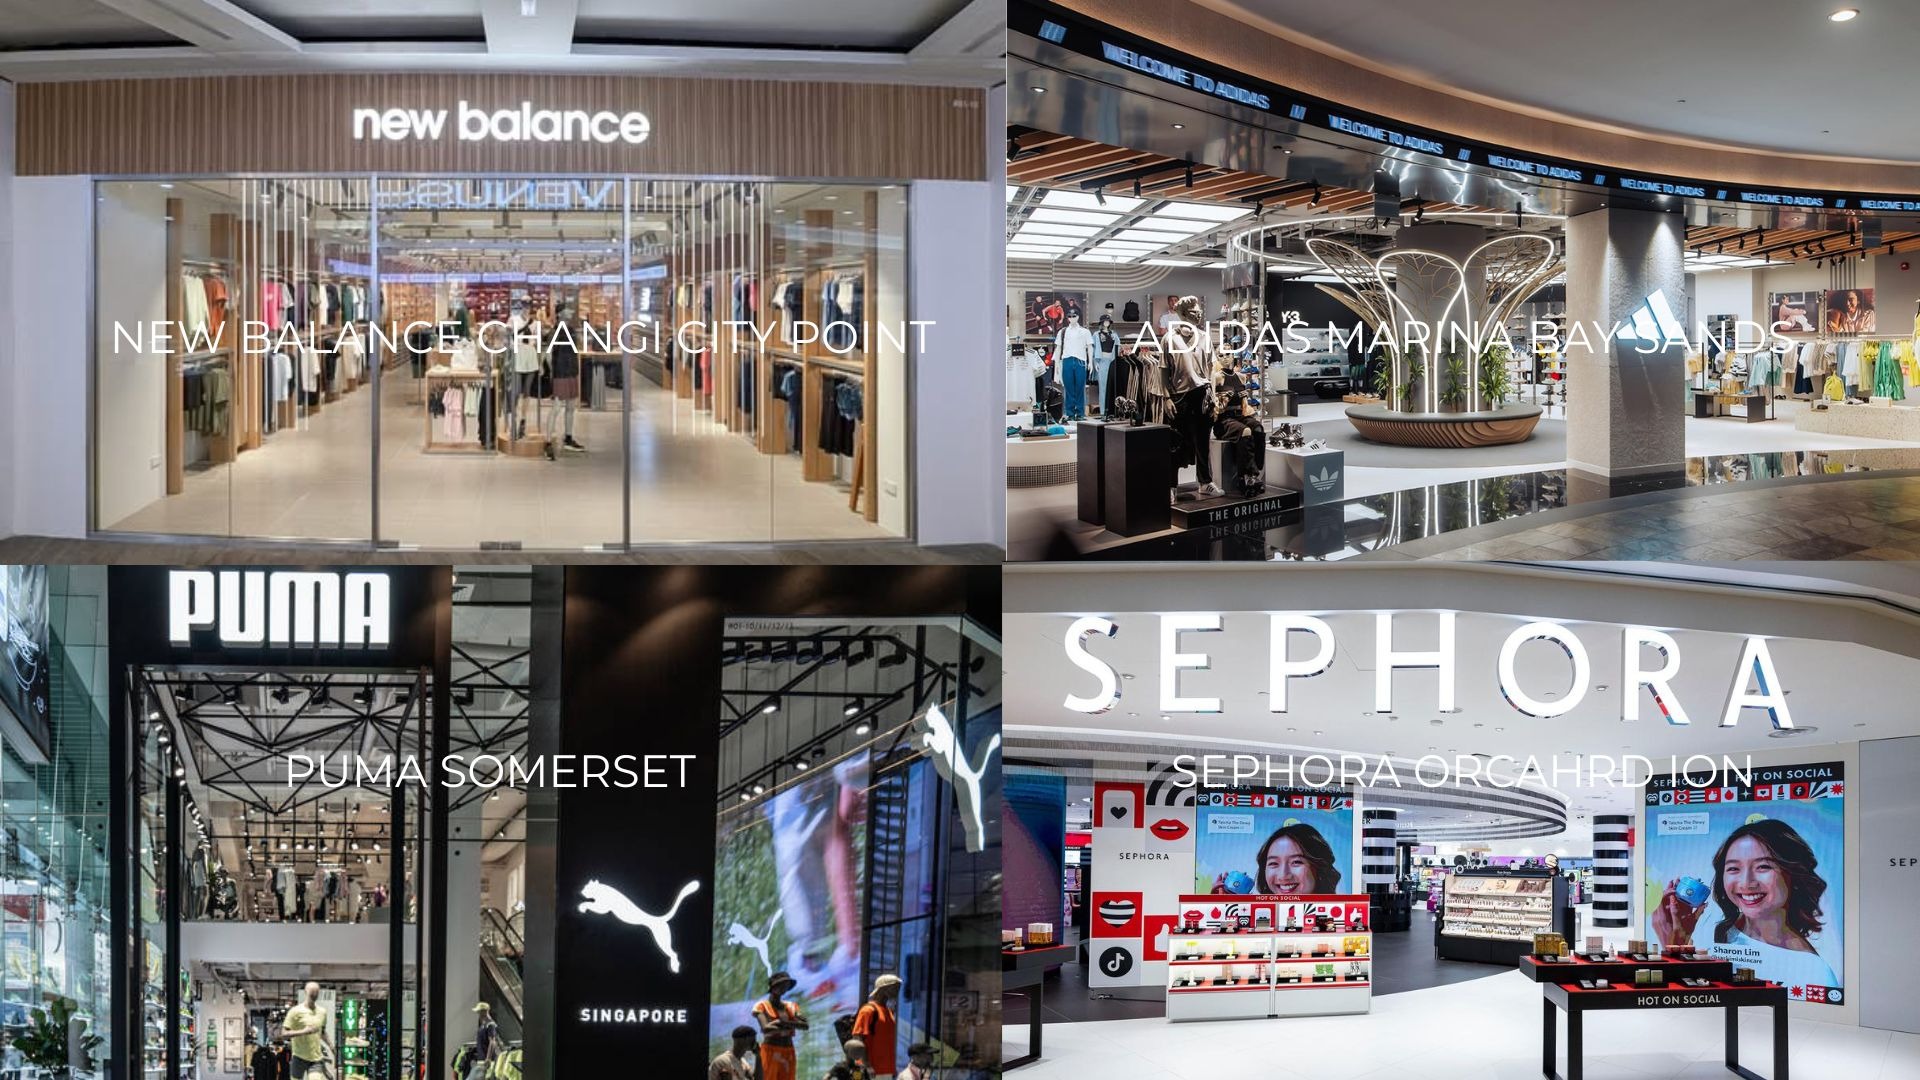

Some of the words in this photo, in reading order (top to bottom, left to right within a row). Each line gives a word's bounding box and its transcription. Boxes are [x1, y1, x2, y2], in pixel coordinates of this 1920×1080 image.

[1101, 40, 1192, 86] WELCOME
[1191, 72, 1215, 93] TO
[1214, 81, 1270, 109] ADIDAS
[354, 107, 448, 141] new
[458, 100, 651, 143] balance
[1328, 114, 1387, 142] WELCOME
[1387, 130, 1404, 145] TO
[1404, 135, 1444, 155] ADIDAS
[1487, 154, 1535, 173] WELCOME
[1533, 163, 1549, 176] TO
[1549, 167, 1582, 180] ADIDAS
[1620, 178, 1662, 192] WELCOME
[1661, 183, 1674, 194] TO
[1674, 185, 1705, 197] ADIDAS
[1740, 192, 1782, 204] WELCOME
[1781, 195, 1793, 204] TO
[1793, 196, 1824, 206] ADIDAS
[1208, 508, 1229, 522] THE
[1234, 499, 1282, 517] ORIGINAL
[169, 570, 391, 647] PUMA
[1063, 612, 1796, 730] SEPHORA
[1763, 771, 1782, 780] ON
[1787, 768, 1833, 779] SOCIAL
[1119, 852, 1170, 861] SEPHORA
[1889, 858, 1918, 867] SEP
[1713, 946, 1743, 955] Sharon
[1744, 948, 1760, 957] Lim
[1637, 996, 1660, 1005] HOT
[1662, 995, 1680, 1005] ON
[1683, 994, 1721, 1004] SOCIAL
[580, 1008, 688, 1023] SINGAPORE
